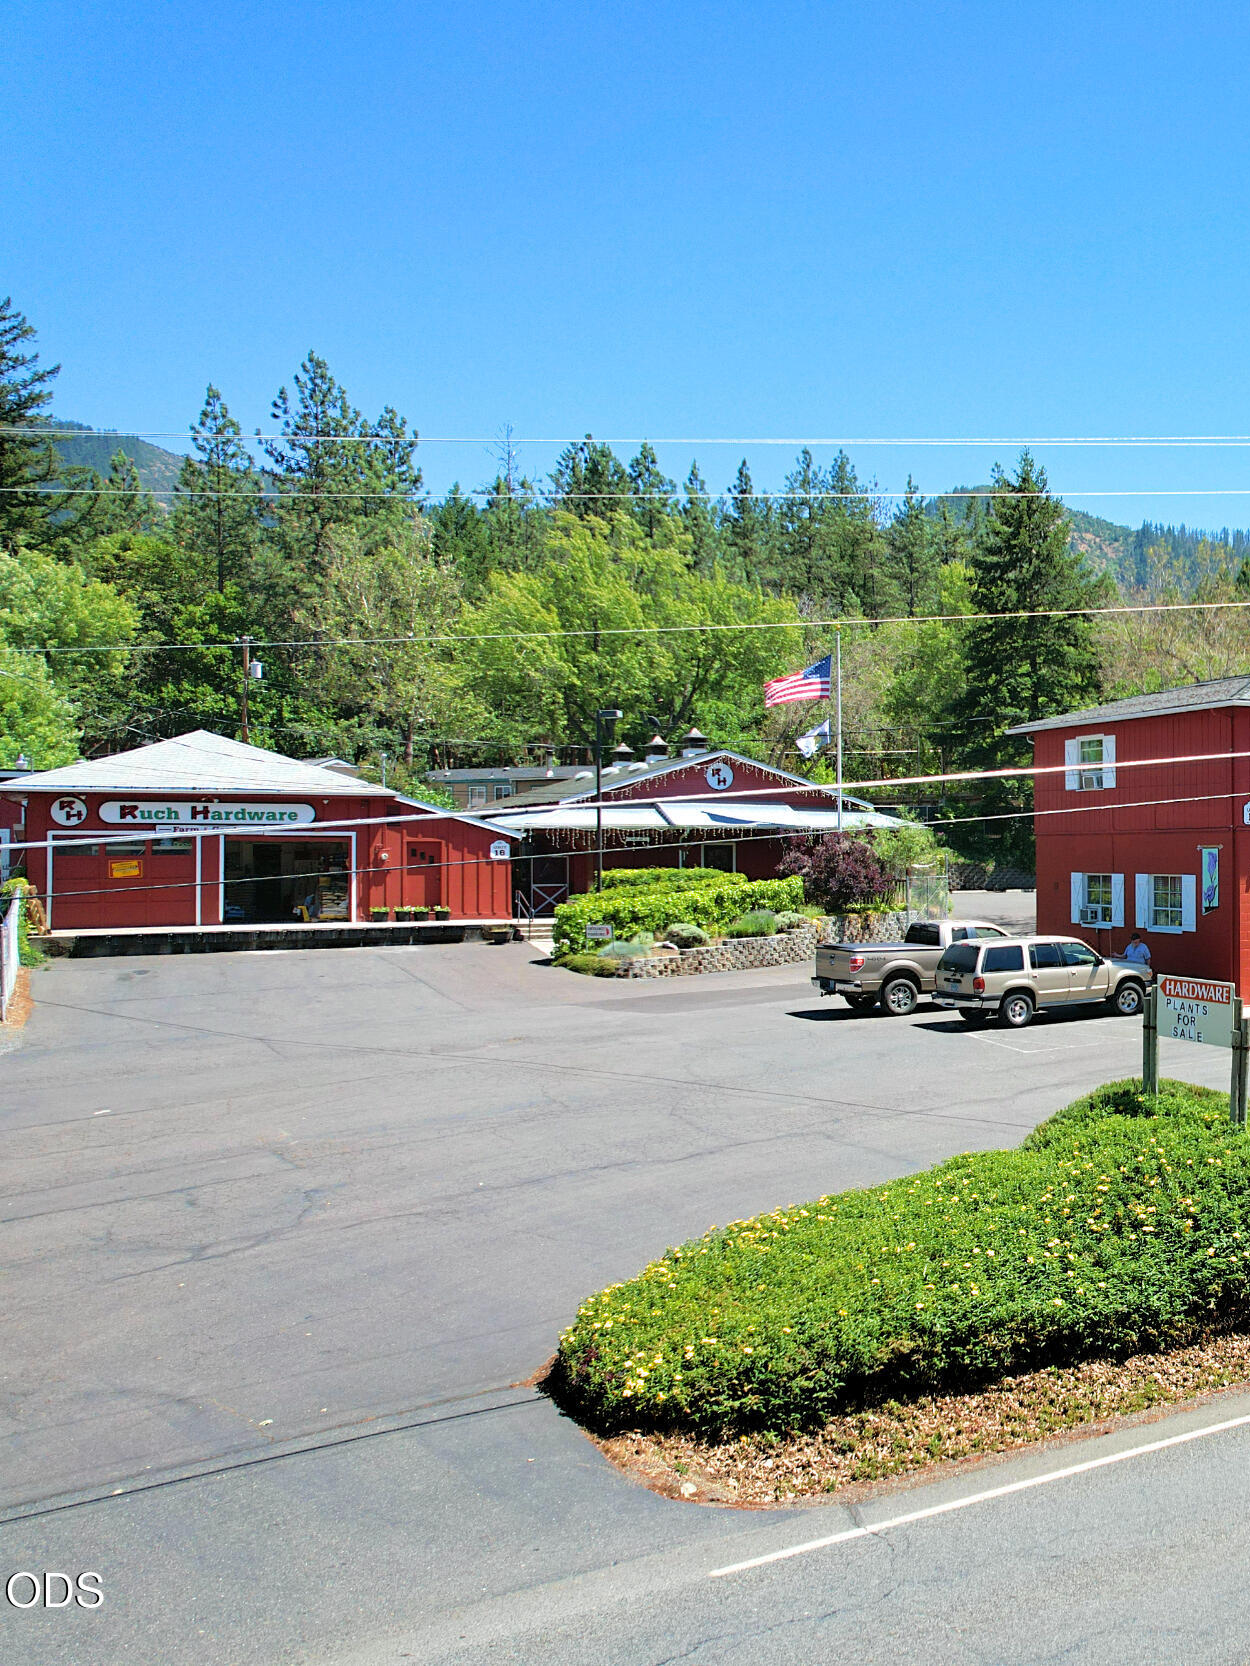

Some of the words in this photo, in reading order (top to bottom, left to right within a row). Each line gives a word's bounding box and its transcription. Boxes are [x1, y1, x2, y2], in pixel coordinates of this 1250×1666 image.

[119, 804, 180, 820] Ruch
[190, 805, 299, 821] Hardware
[1165, 980, 1230, 1003] HARDWARE
[1166, 998, 1208, 1016] PLANTS
[1177, 1013, 1196, 1027] FOR
[1172, 1026, 1203, 1043] SALE
